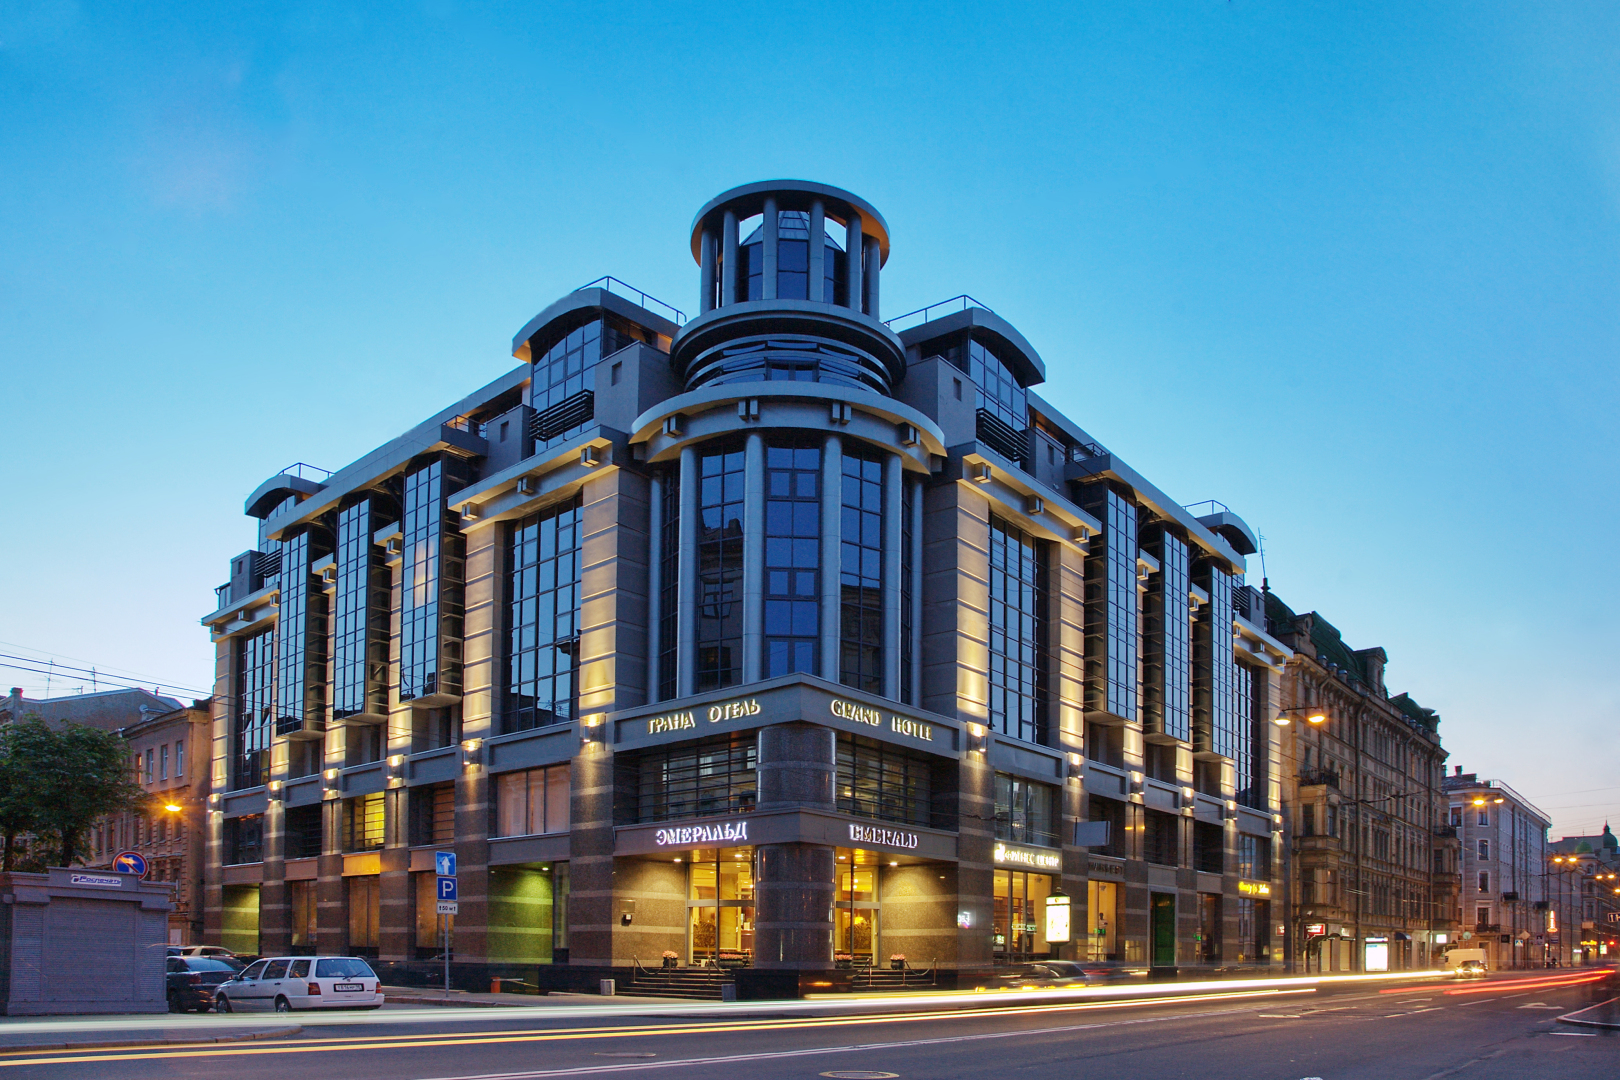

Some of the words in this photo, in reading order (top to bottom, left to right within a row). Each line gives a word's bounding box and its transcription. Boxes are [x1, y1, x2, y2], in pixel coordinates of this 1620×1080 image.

[647, 711, 696, 735] ГРАНД
[707, 698, 761, 723] ОТЕЛЬ
[830, 699, 882, 727] GRAND
[891, 716, 933, 741] HOTEL
[655, 821, 747, 845] ЭМЕРАЛЬД
[849, 823, 919, 849] EMERALD
[1004, 850, 1036, 865] ФИТНЕС
[80, 875, 121, 885] Роспечать
[442, 880, 454, 898] P
